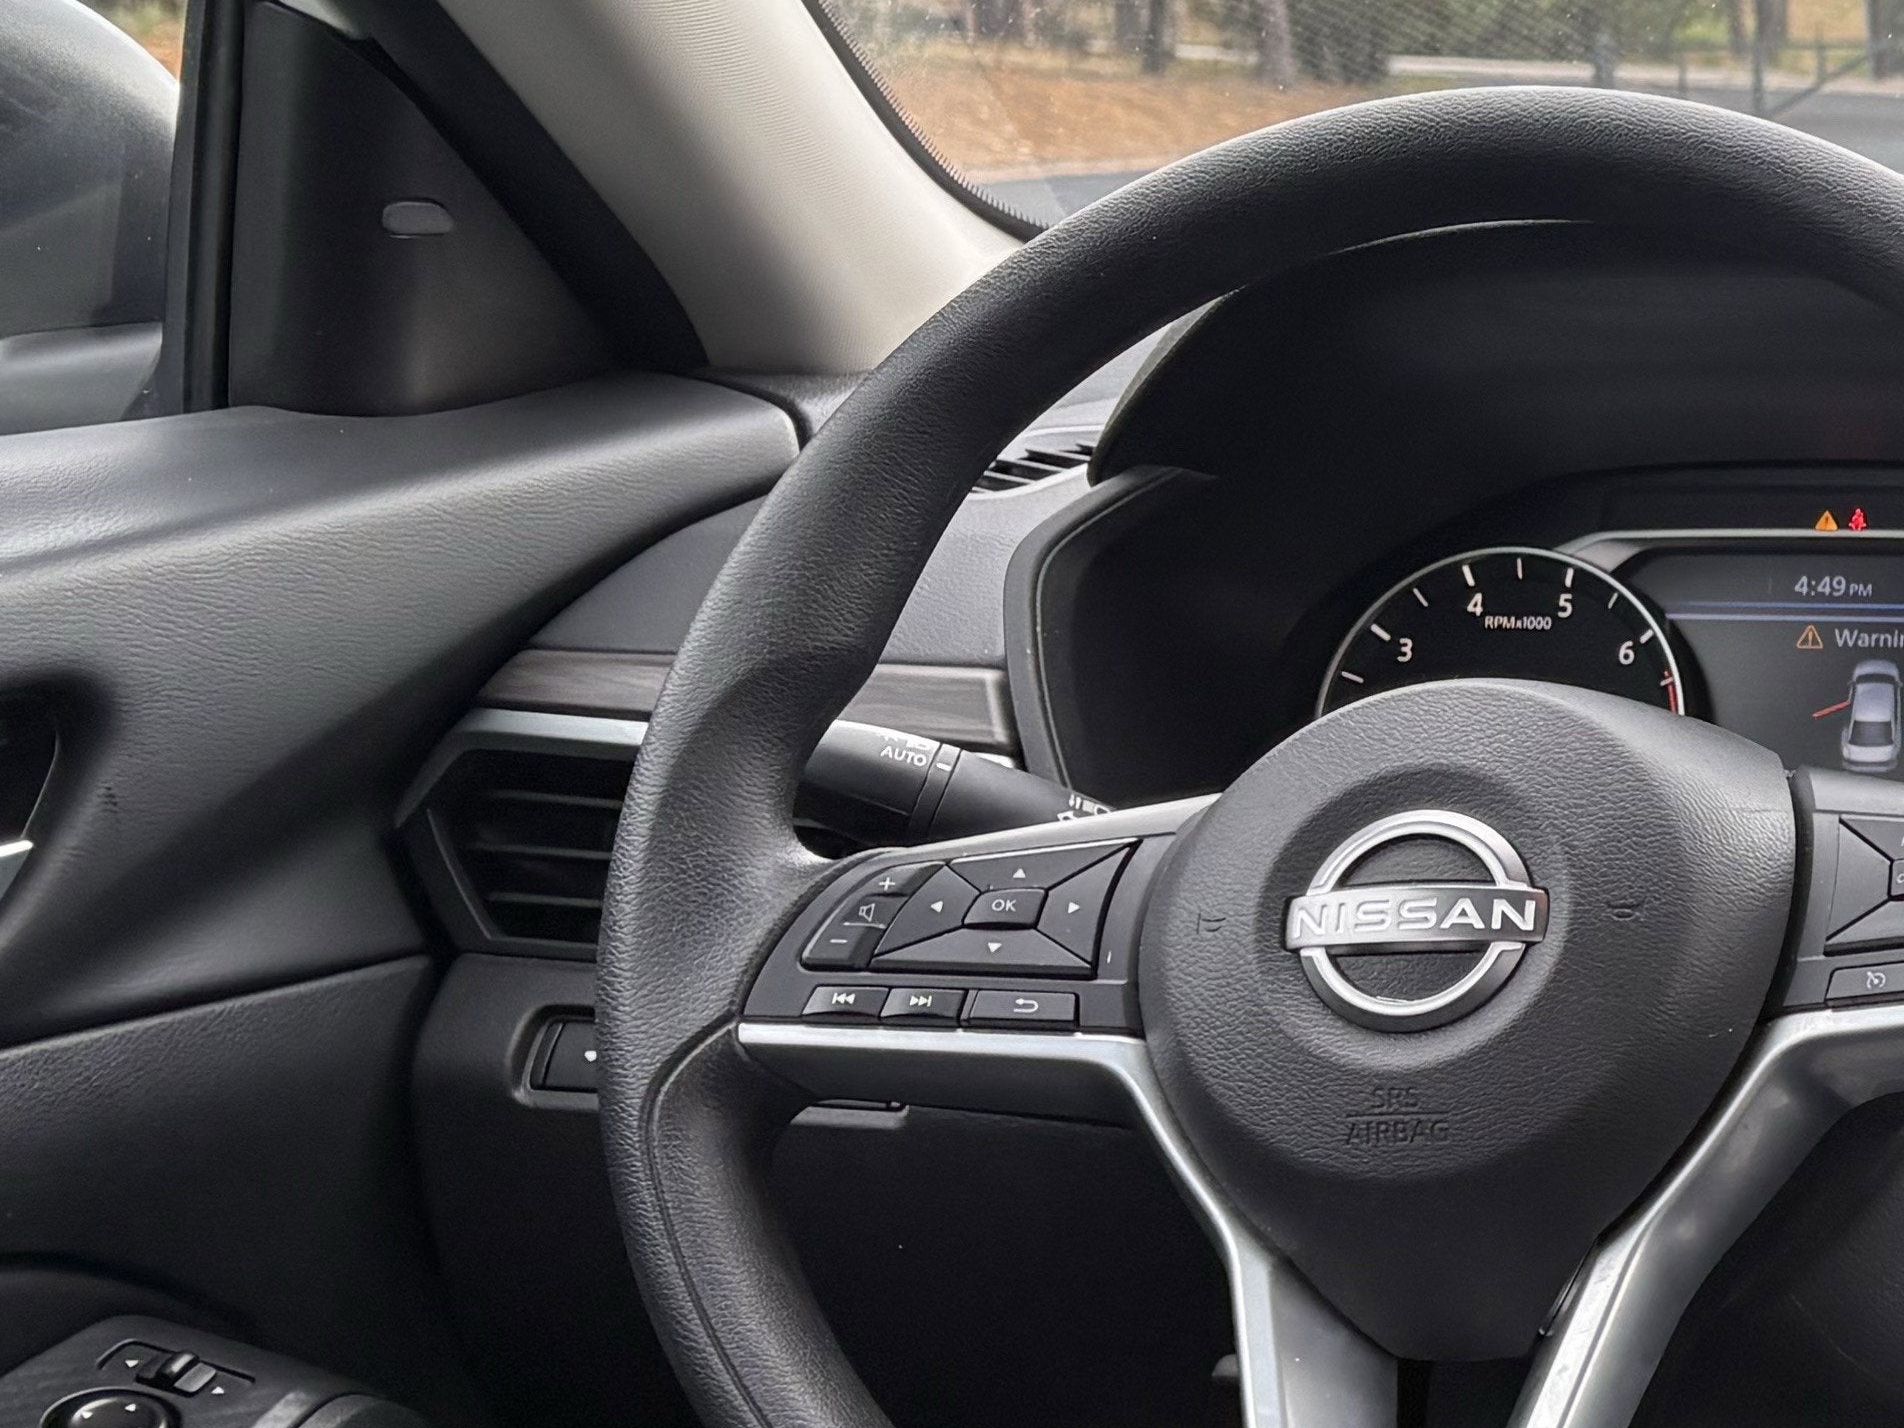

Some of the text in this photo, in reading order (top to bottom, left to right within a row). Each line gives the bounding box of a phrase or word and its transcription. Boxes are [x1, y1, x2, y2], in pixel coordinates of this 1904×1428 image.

[1466, 593, 1483, 617] 4
[1557, 593, 1573, 618] 5
[1397, 638, 1413, 662] 3
[1618, 641, 1635, 665] 6
[880, 746, 928, 767] AUTO
[992, 897, 1017, 912] OK
[1294, 898, 1536, 936] NISSAN
[1371, 1087, 1420, 1110] SRS
[1344, 1120, 1449, 1146] AIRBAG
